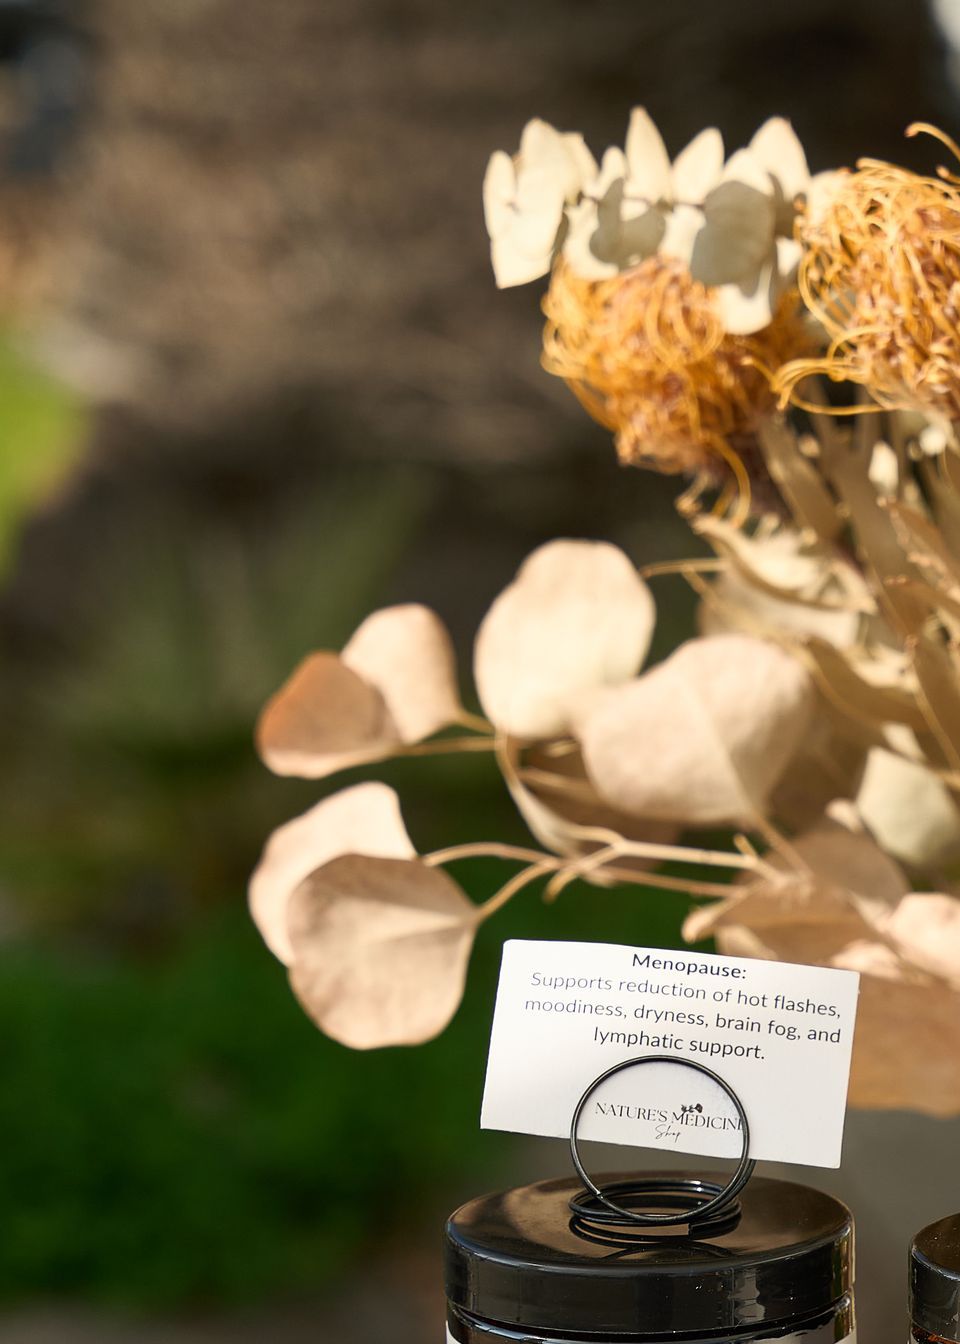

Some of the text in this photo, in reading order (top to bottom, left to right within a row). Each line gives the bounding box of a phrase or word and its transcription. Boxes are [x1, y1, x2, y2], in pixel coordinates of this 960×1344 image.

[632, 953, 747, 980] Menopause:
[530, 971, 841, 1018] Supports reduction of hot flashes,
[524, 996, 841, 1044] moodiness, dryness, brain fog, and
[593, 1026, 766, 1060] lymphatic support.
[595, 1102, 669, 1123] NATURE'S
[654, 1124, 682, 1143] Shop
